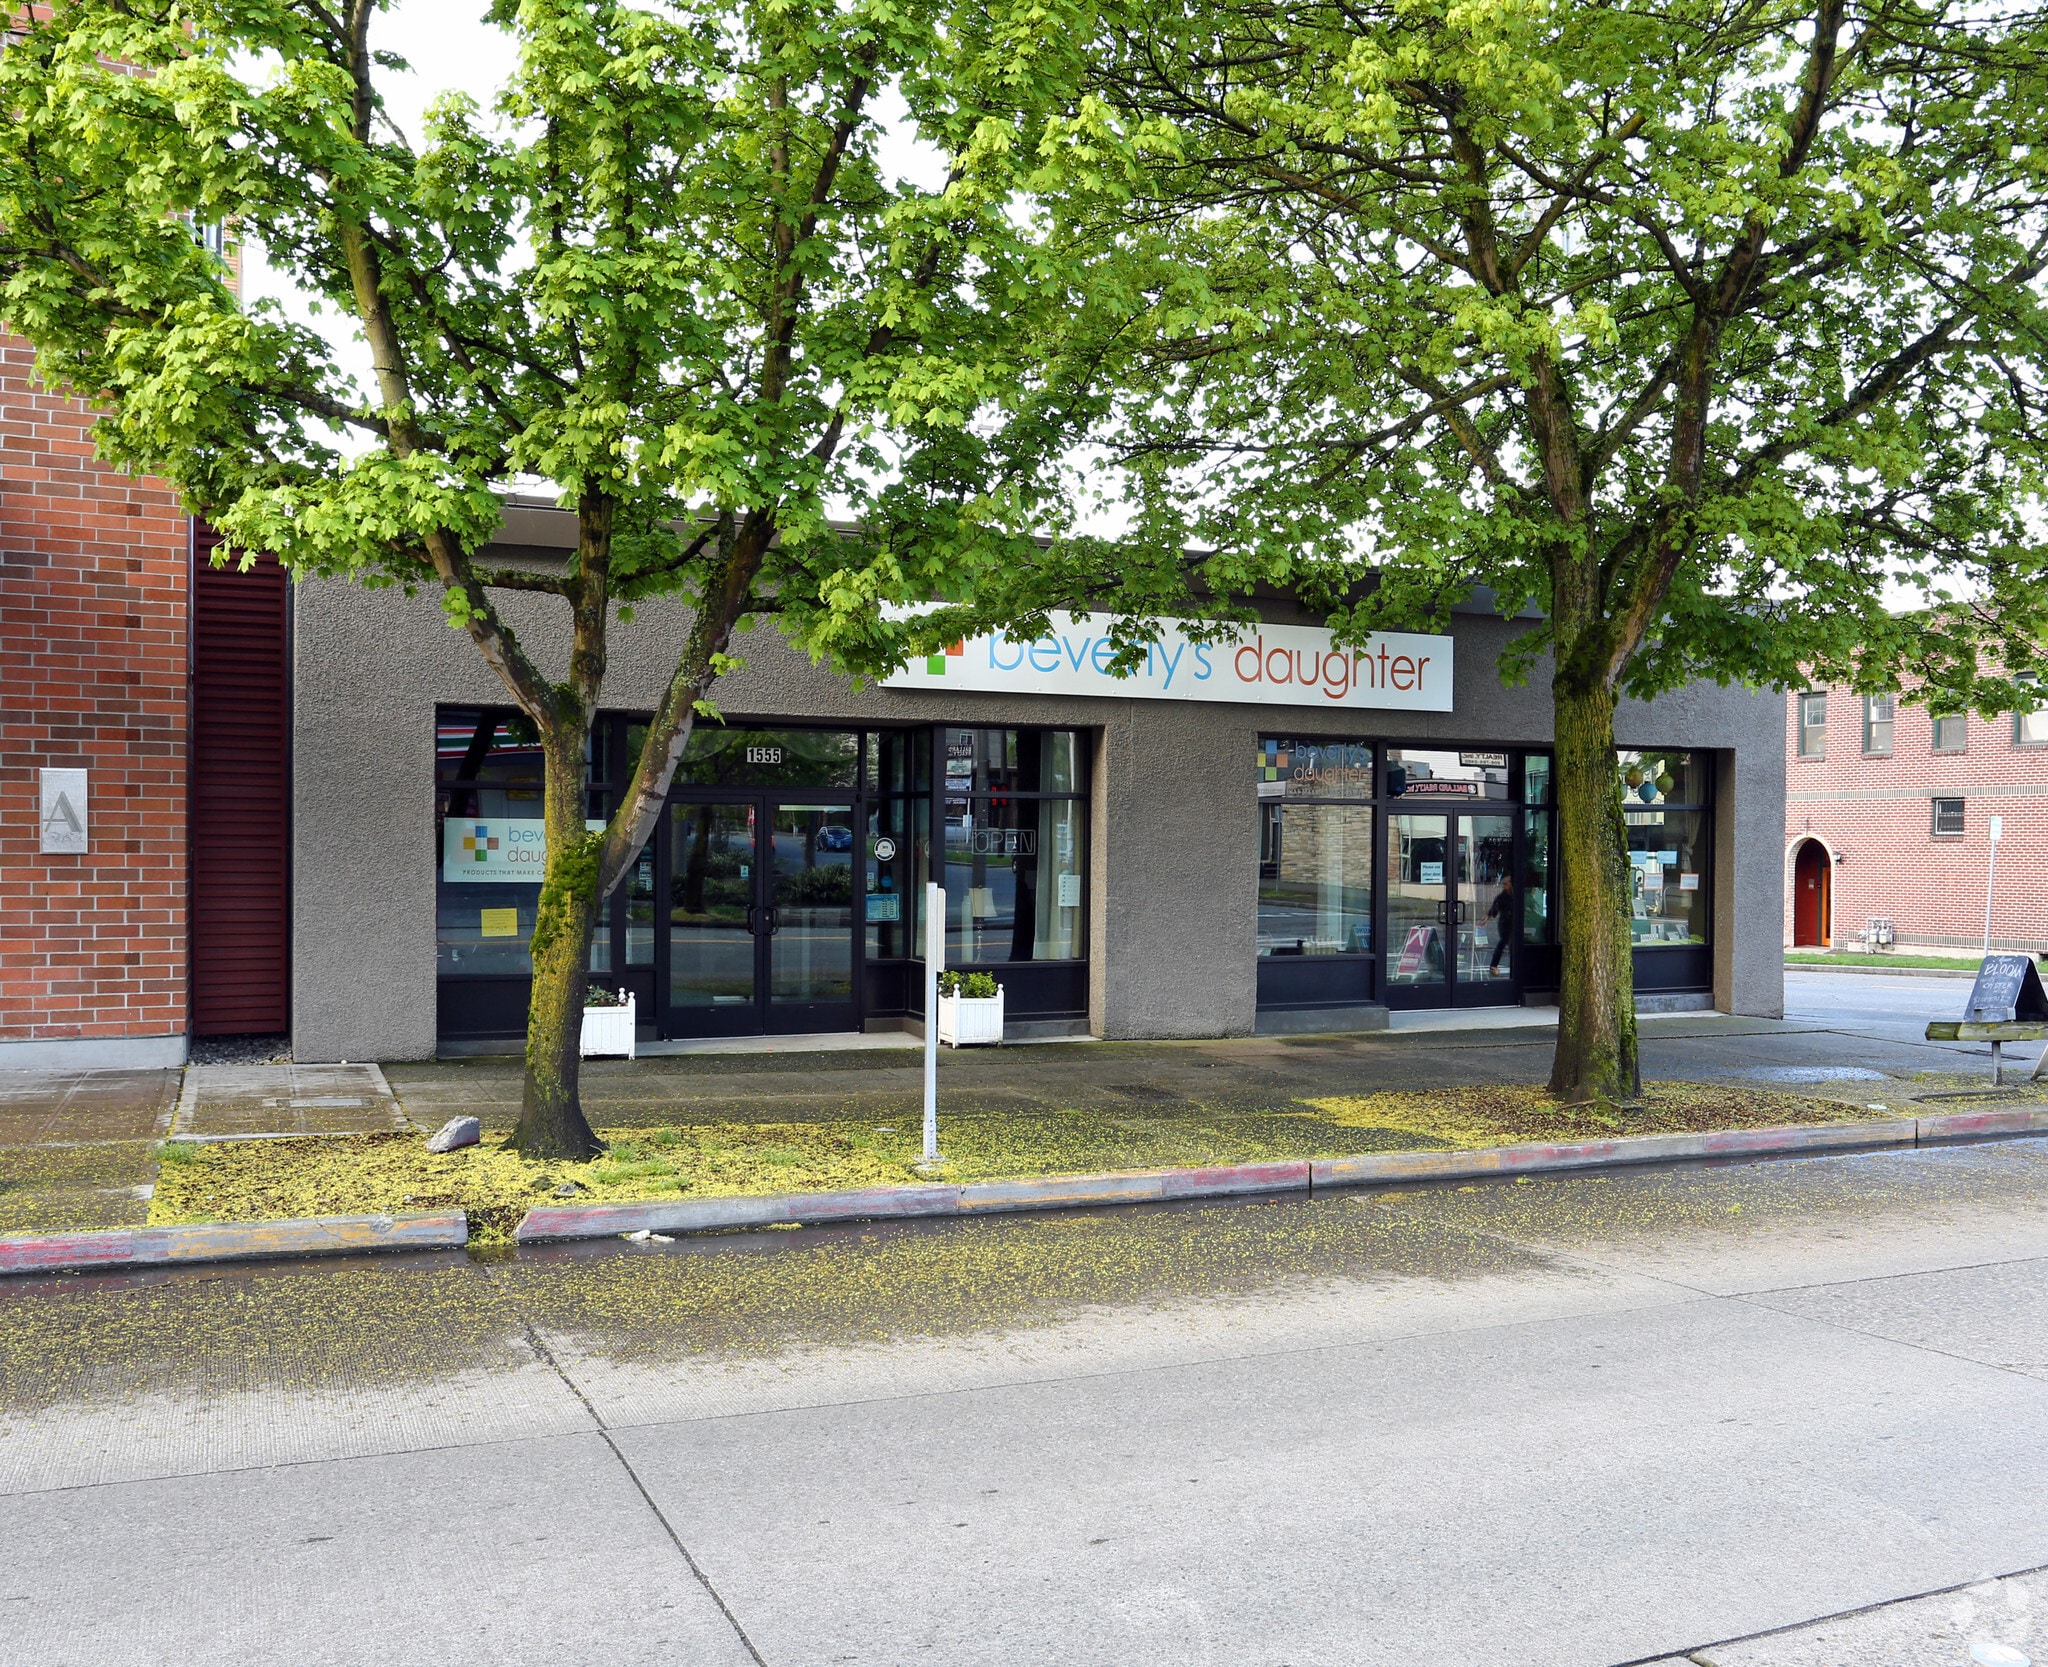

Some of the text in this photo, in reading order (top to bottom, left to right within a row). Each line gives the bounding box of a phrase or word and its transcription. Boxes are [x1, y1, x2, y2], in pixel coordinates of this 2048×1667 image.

[1235, 634, 1431, 699] daughter
[748, 748, 780, 763] 1555
[1295, 740, 1367, 764] beverly's
[1293, 763, 1364, 785] daughter
[42, 791, 83, 833] A
[975, 831, 1033, 853] OPEN
[1984, 963, 2022, 977] BLOOM
